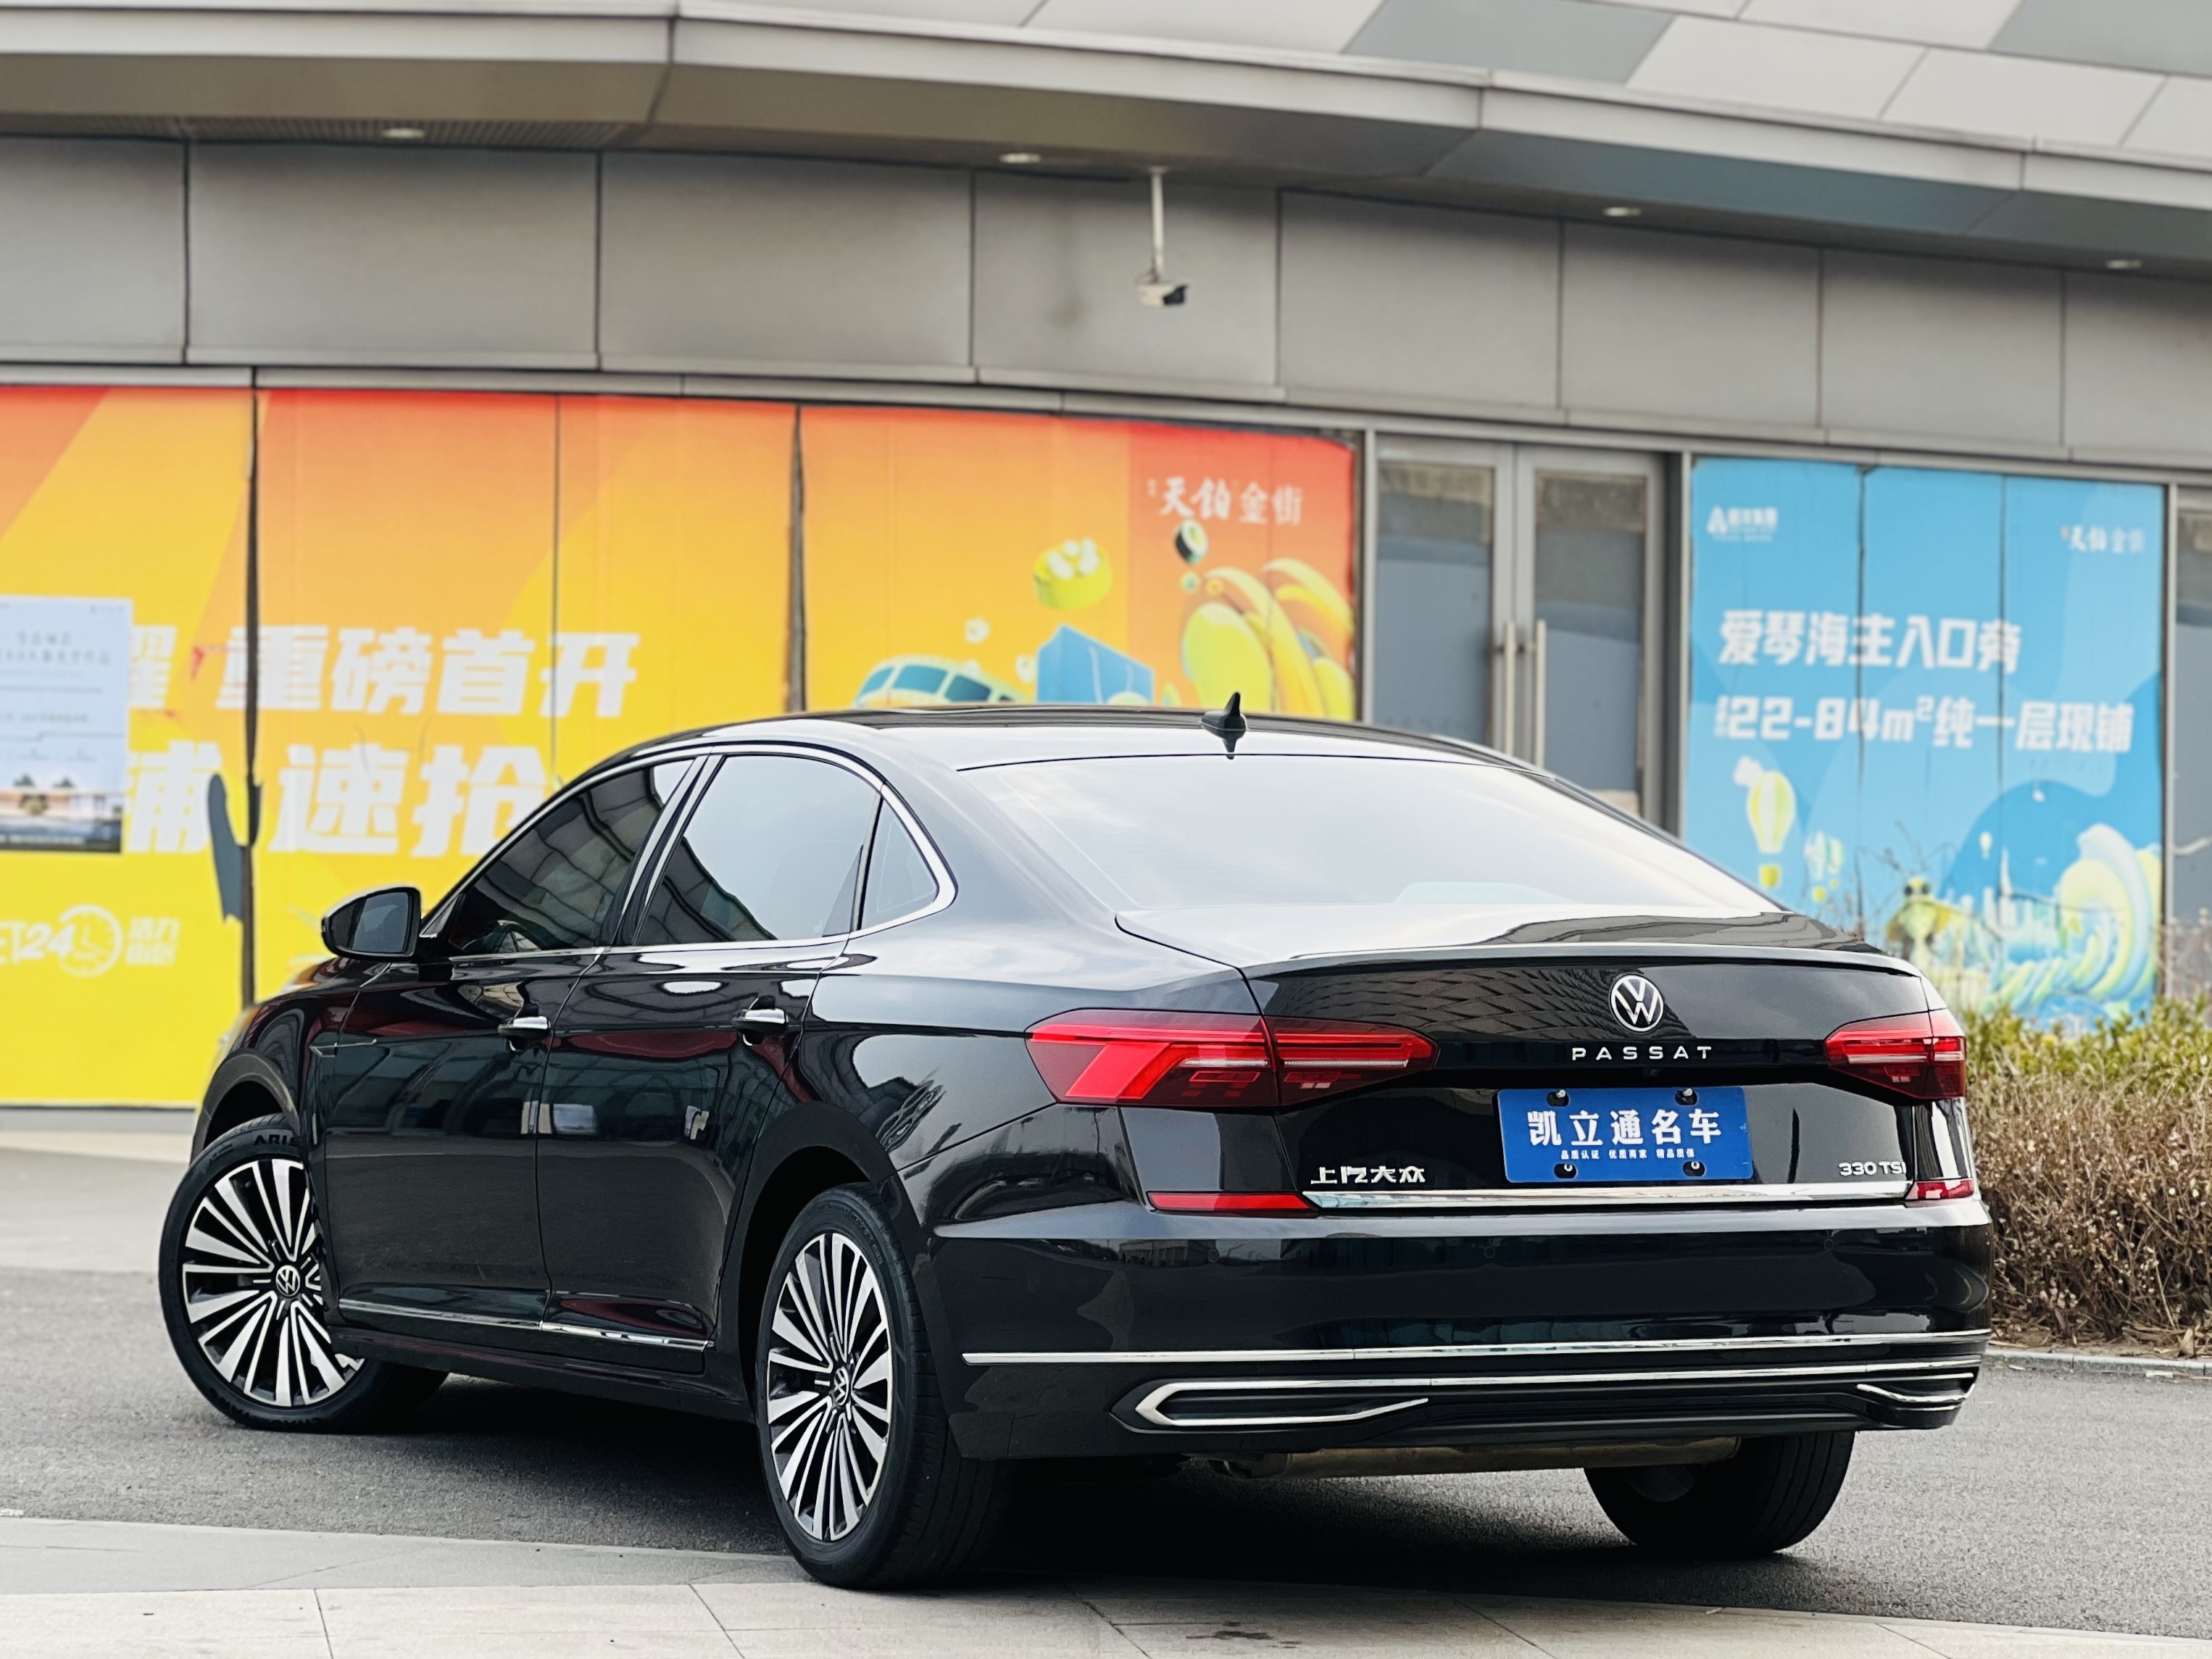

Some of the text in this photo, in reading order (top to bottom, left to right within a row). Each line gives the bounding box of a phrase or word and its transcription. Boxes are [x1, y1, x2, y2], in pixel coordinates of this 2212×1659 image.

[1571, 1045, 1713, 1061] PASSAT
[1527, 1108, 1722, 1147] 凯立通名车
[1310, 1165, 1426, 1185] 上汽大众
